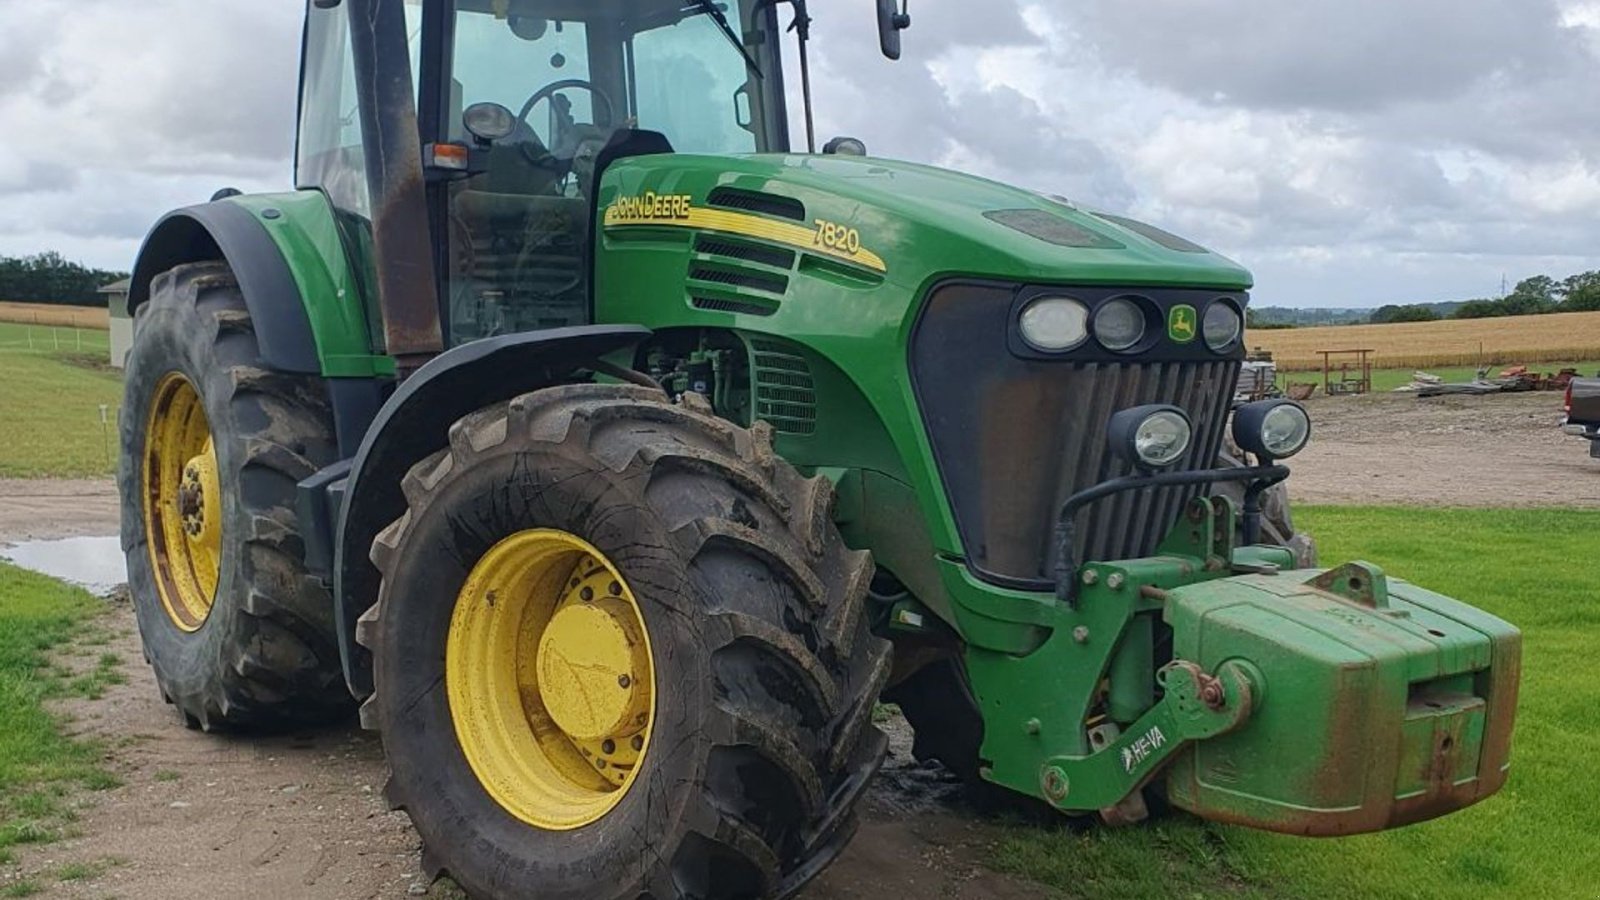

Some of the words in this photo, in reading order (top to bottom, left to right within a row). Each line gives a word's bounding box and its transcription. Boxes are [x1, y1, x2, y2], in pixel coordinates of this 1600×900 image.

[611, 194, 644, 219] JOHN
[645, 191, 692, 219] DEERE
[814, 218, 860, 254] 7820
